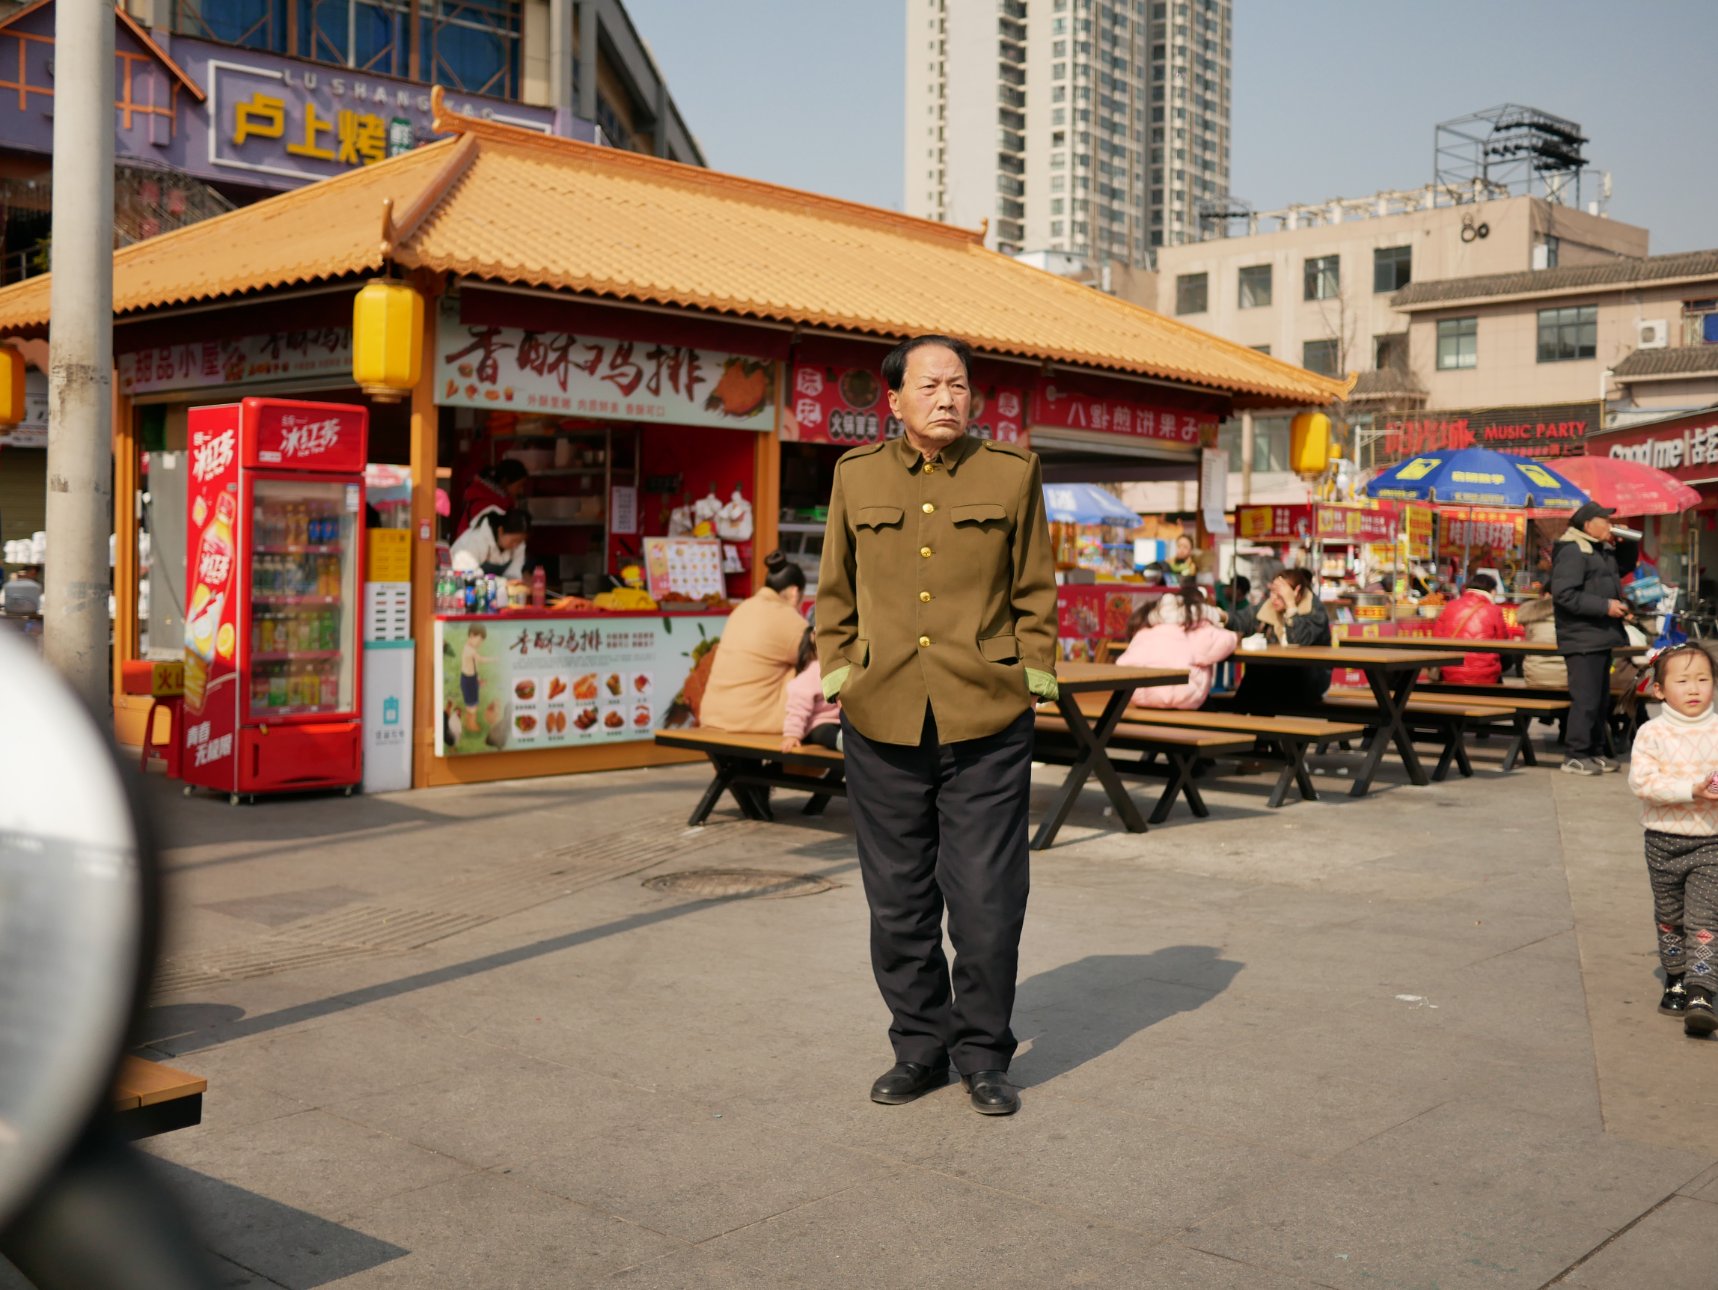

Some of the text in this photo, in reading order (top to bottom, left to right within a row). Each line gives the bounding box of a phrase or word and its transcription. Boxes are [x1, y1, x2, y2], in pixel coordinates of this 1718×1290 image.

[284, 69, 317, 90] LU
[331, 78, 430, 112] SHANG
[232, 92, 387, 166] 卢上烤
[446, 327, 708, 402] 香酥鸡排
[279, 418, 342, 458] 冰红茶
[1484, 421, 1586, 441] MUSIC PARTY
[192, 429, 236, 484] 冰红茶
[509, 627, 603, 655] 香酥鸡排
